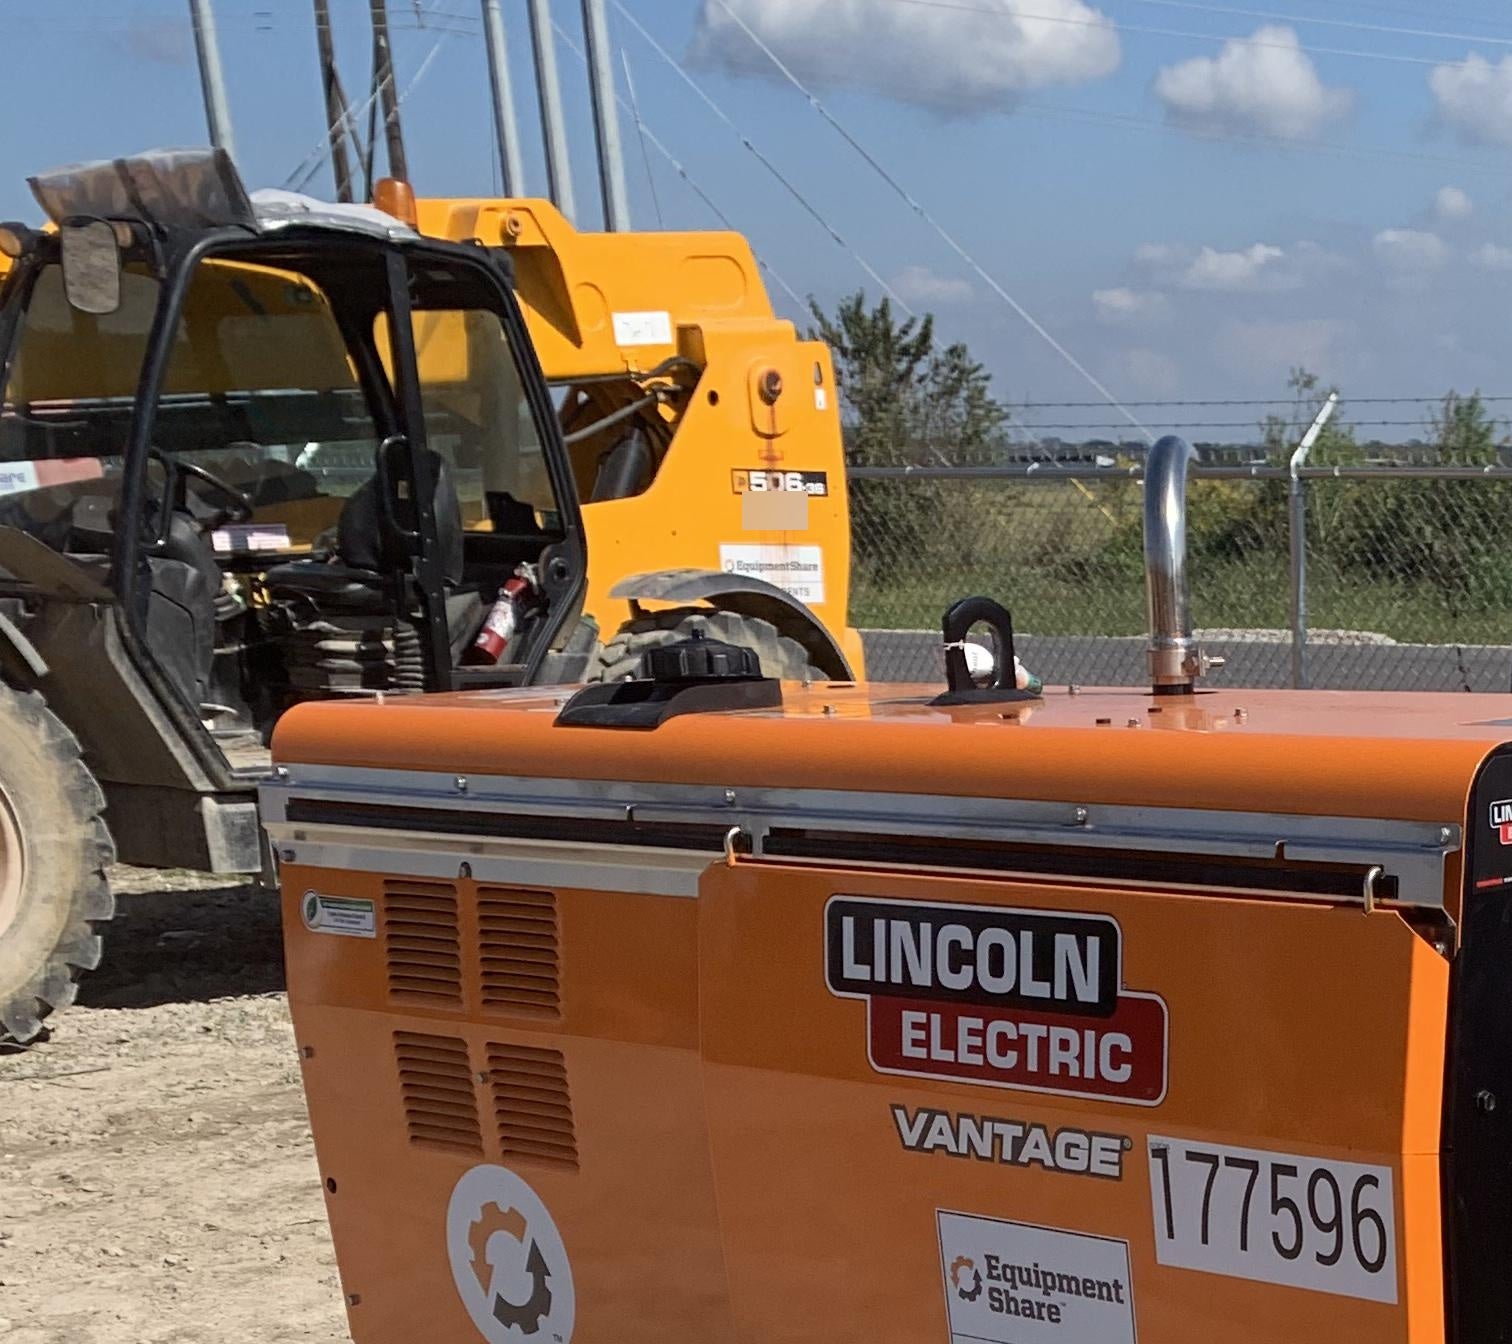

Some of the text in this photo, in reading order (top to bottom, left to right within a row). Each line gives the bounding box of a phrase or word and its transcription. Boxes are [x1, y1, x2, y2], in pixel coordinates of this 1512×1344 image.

[736, 560, 819, 573] EquipmentShare
[842, 916, 1100, 1004] LINCOLN
[902, 1010, 1132, 1083] ELECTRIC
[893, 1108, 1122, 1177] VANTAGE
[1151, 1147, 1387, 1273] 177596
[984, 1254, 1125, 1304] Equipment
[988, 1287, 1061, 1323] Share
